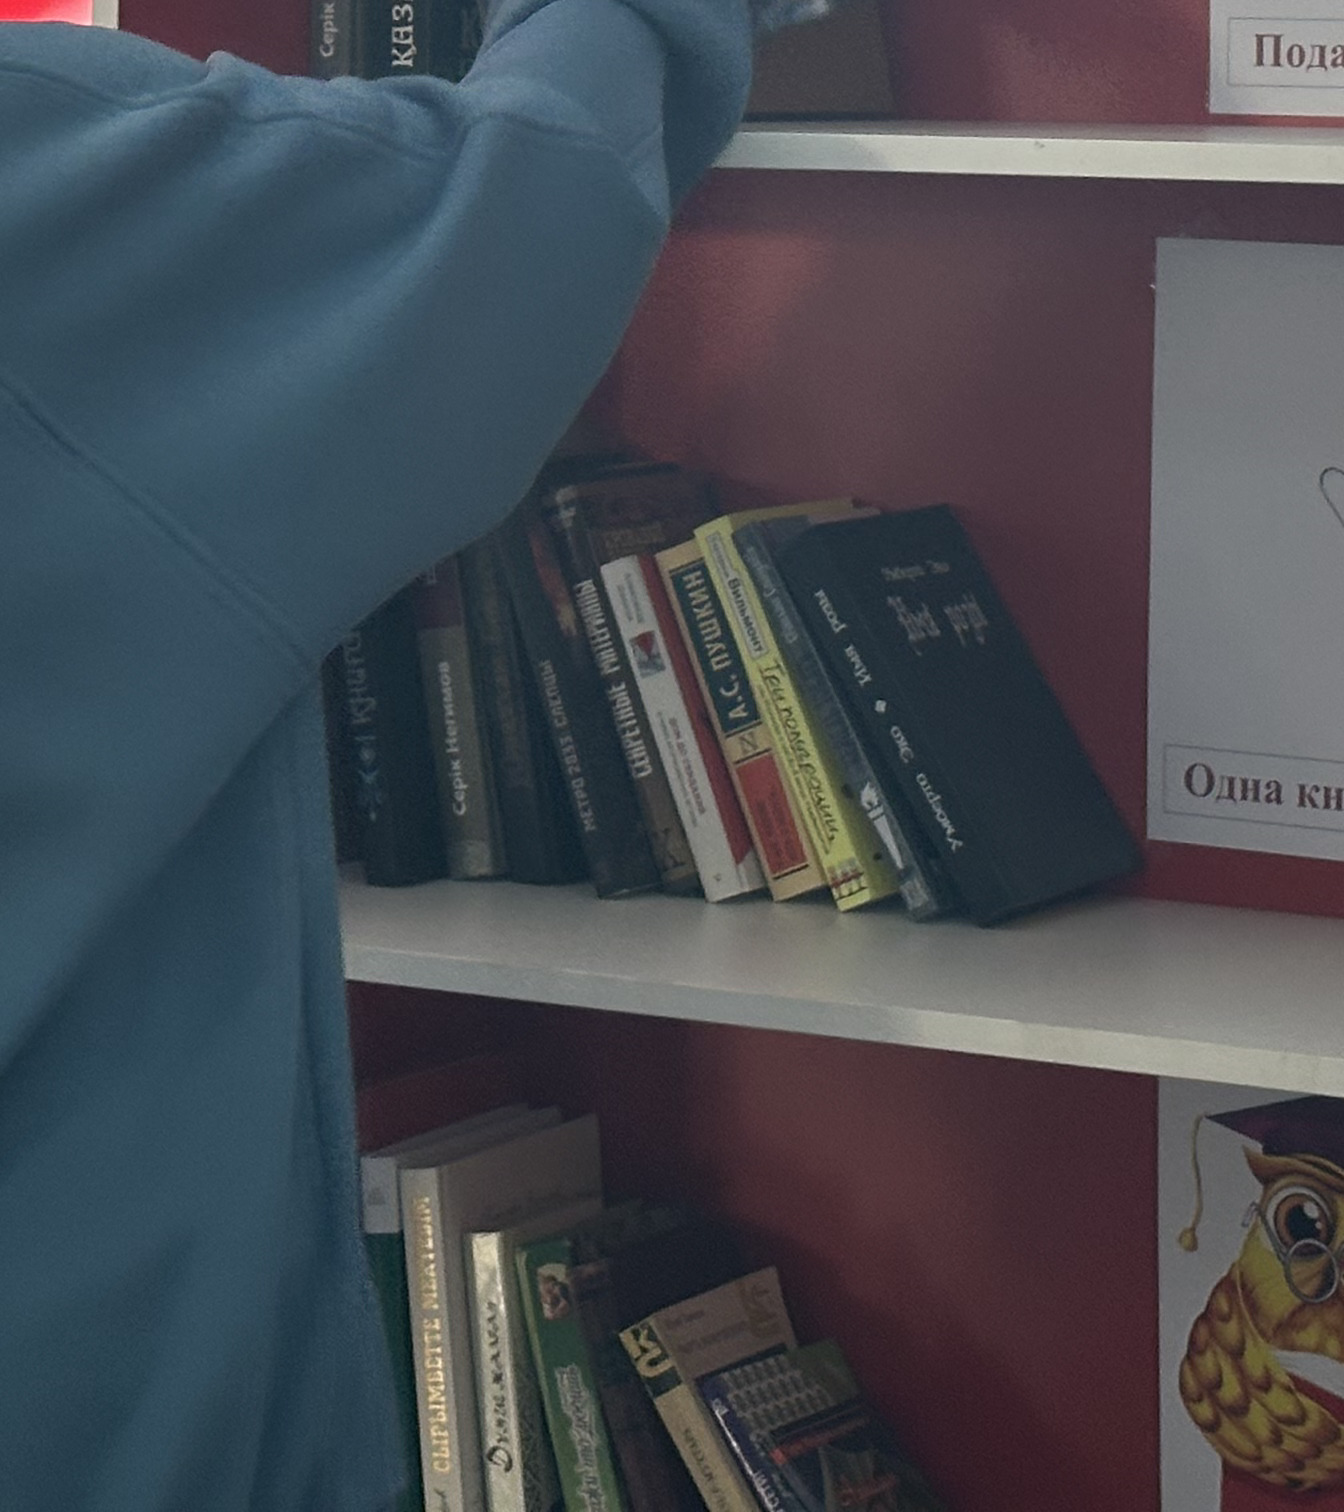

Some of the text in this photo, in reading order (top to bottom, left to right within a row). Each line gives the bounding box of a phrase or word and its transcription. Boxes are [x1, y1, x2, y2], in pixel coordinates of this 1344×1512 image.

[320, 3, 338, 57] Серік
[727, 578, 768, 657] Вильмонт
[814, 589, 847, 633] розы
[682, 569, 750, 719] А.С. ПУШКИН
[845, 644, 874, 687] Имя
[539, 659, 569, 728] СЛЕПЦЫ
[574, 579, 653, 779] СЕКРЕТНЫЕ МАТЕРИАЛЫ
[762, 663, 787, 698] Три
[438, 661, 468, 815] Серік Негимов
[890, 725, 916, 763] Эко
[573, 777, 598, 831] МЕТРО
[1184, 762, 1284, 808] Одна
